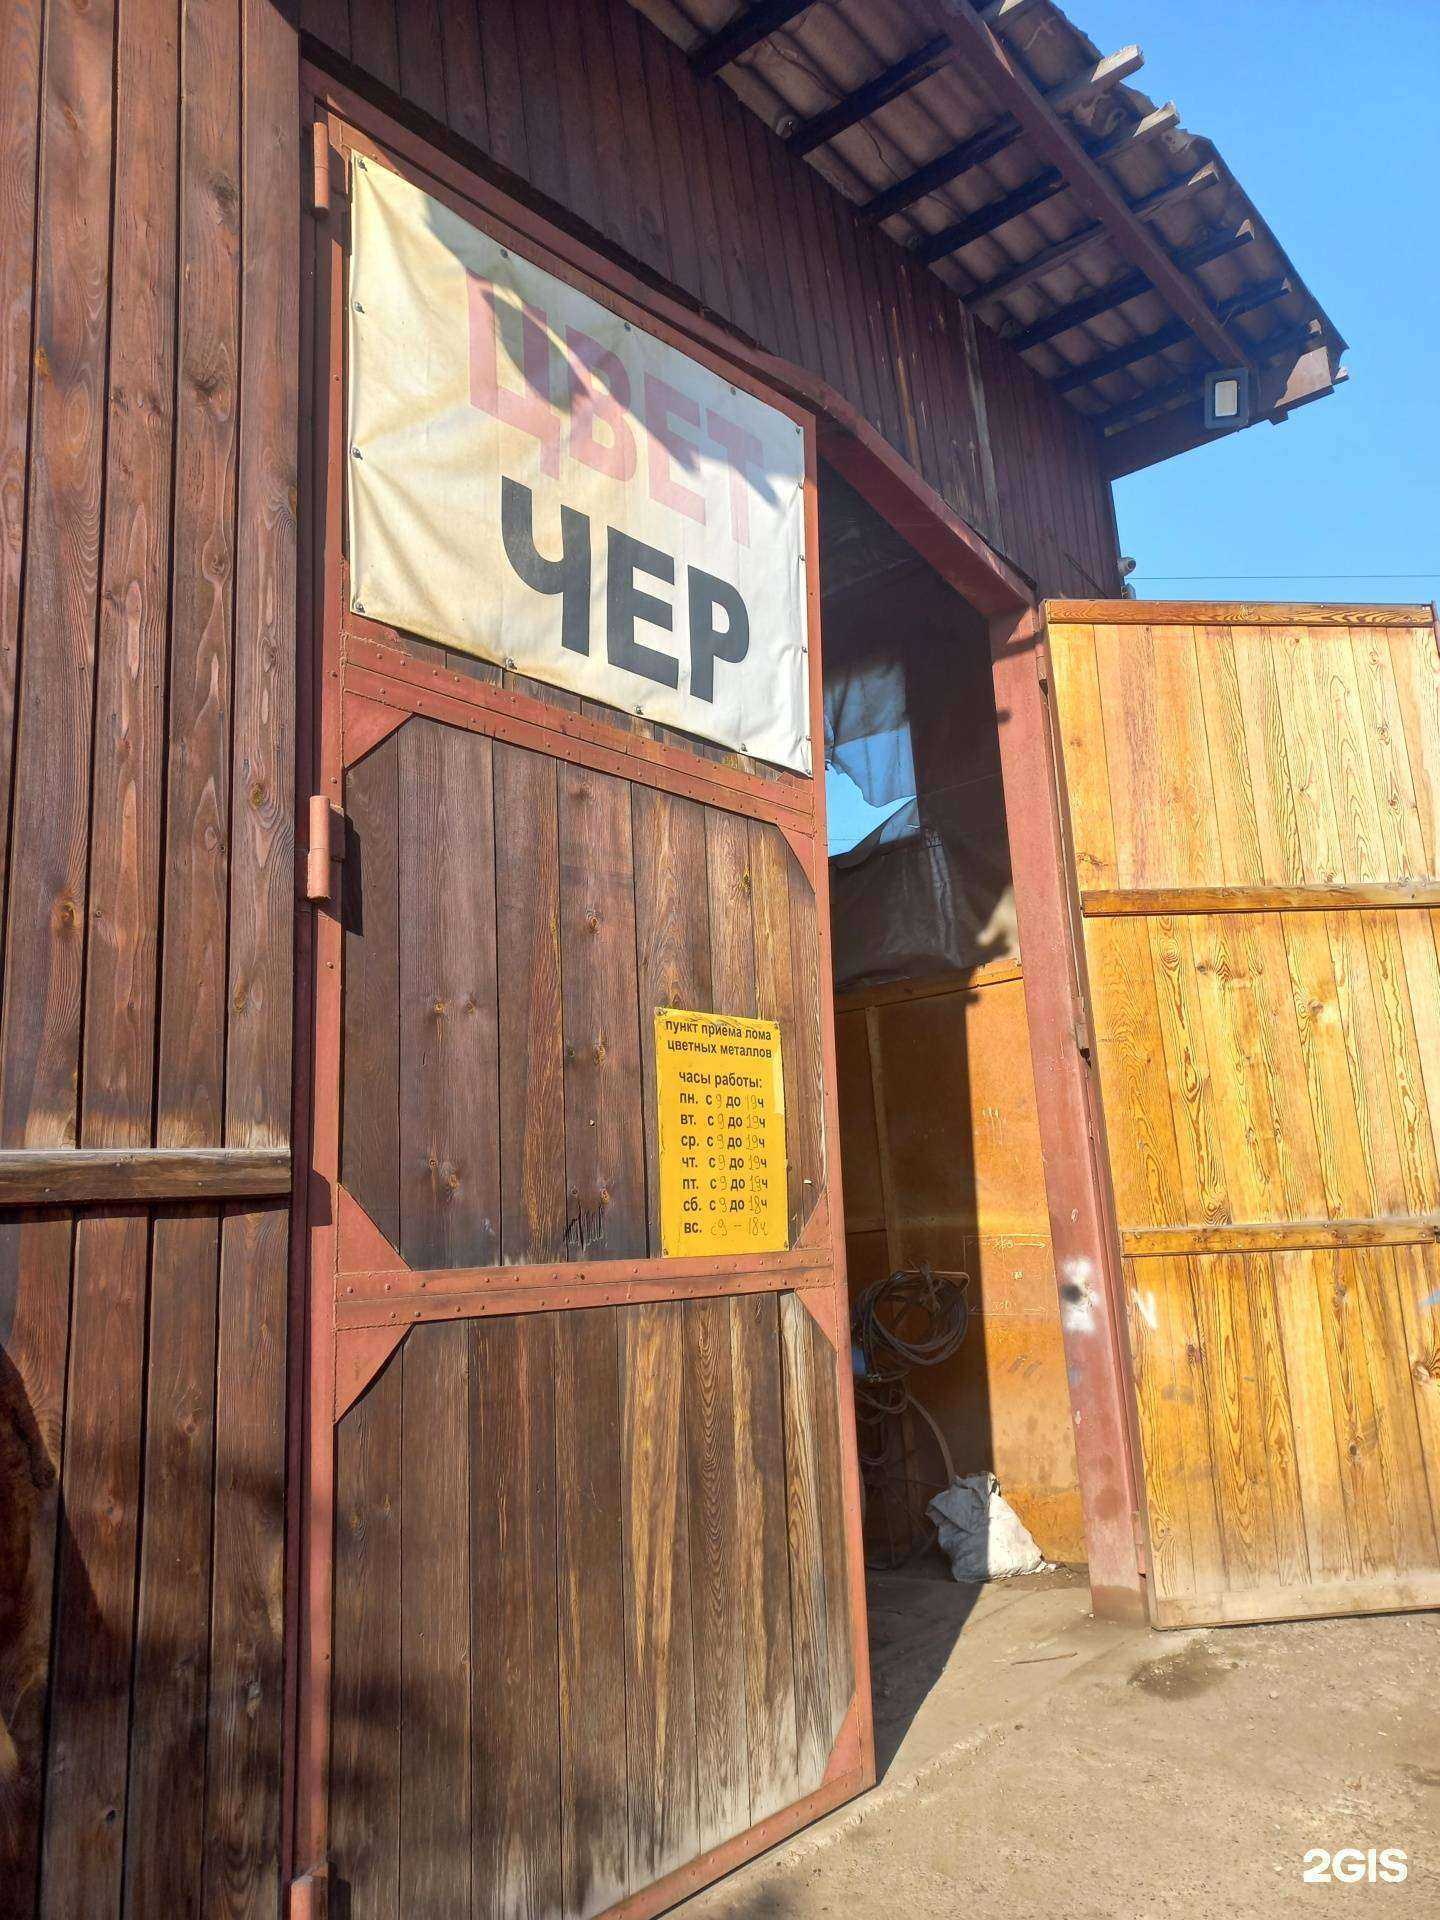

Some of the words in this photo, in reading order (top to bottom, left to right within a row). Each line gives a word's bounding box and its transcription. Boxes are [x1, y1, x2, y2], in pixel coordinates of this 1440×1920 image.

[467, 270, 765, 548] ЦВЕТ
[501, 475, 750, 703] ЧЕР
[666, 1021, 698, 1034] пункт
[745, 1029, 771, 1040] лома
[668, 1040, 716, 1053] цветных
[721, 1045, 771, 1058] металлов
[679, 1072, 710, 1084] часы
[715, 1073, 762, 1088] работы:
[680, 1093, 698, 1104] пн.
[706, 1095, 712, 1105] с
[726, 1096, 740, 1108] до
[681, 1115, 696, 1125] вт.
[708, 1116, 714, 1125] с
[728, 1117, 742, 1129] до
[681, 1135, 699, 1149] ср.
[707, 1137, 713, 1146] с
[727, 1137, 741, 1149] до
[682, 1158, 697, 1167] чт.
[709, 1158, 715, 1168] с
[730, 1158, 744, 1170] до
[683, 1179, 698, 1189] пт.
[710, 1179, 716, 1189] с
[731, 1179, 745, 1191] до
[684, 1197, 701, 1211] сб.
[710, 1200, 716, 1210] с
[730, 1200, 744, 1212] до
[685, 1223, 701, 1233] вс.
